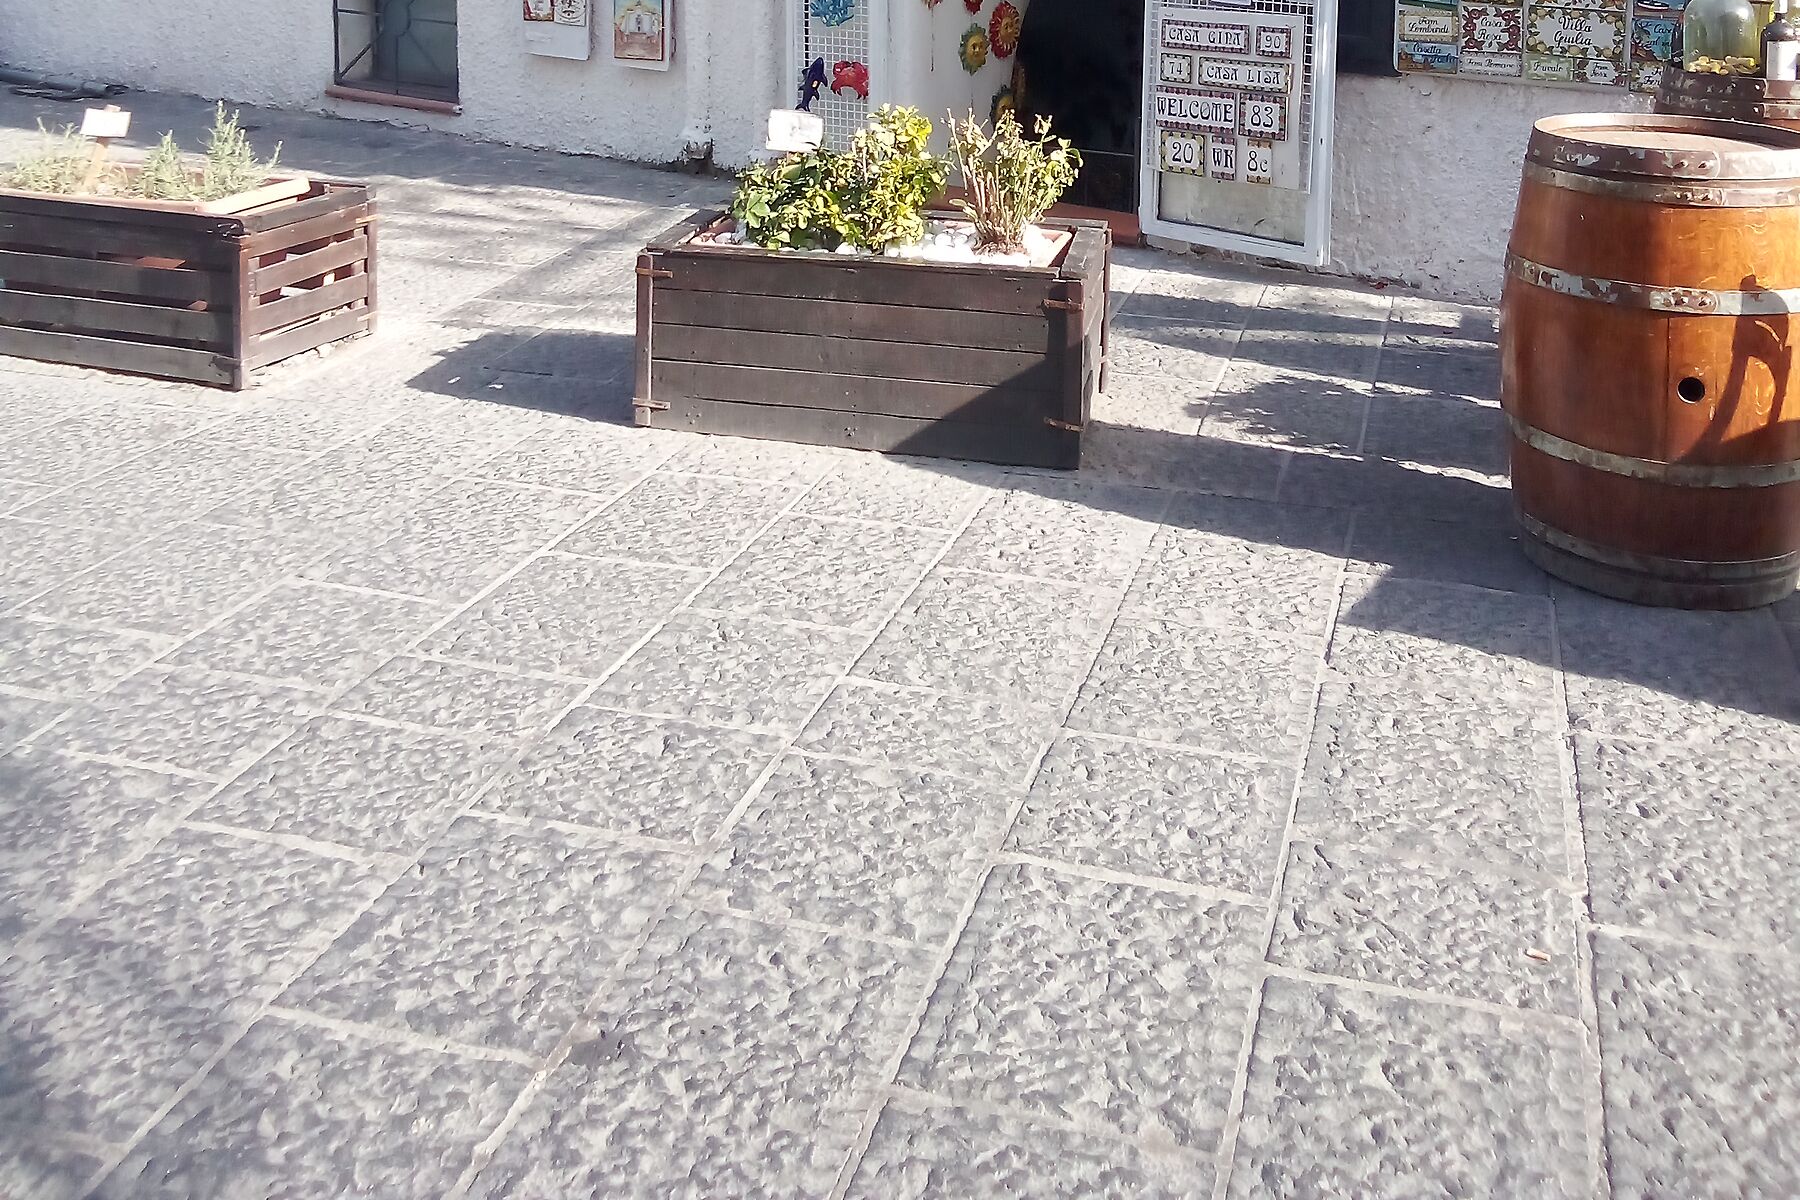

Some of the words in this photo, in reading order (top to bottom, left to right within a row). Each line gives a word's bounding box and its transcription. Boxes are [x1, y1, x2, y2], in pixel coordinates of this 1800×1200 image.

[1480, 17, 1503, 28] Casa
[1558, 16, 1593, 32] Villa
[1168, 27, 1200, 43] CASA
[1264, 35, 1282, 49] 90
[1554, 30, 1593, 48] Giulia
[1169, 61, 1183, 76] 74
[1206, 65, 1239, 81] CASA
[1248, 69, 1281, 85] LISA
[1156, 96, 1234, 124] WELCOME
[1250, 104, 1274, 128] 83
[1171, 141, 1194, 164] 20
